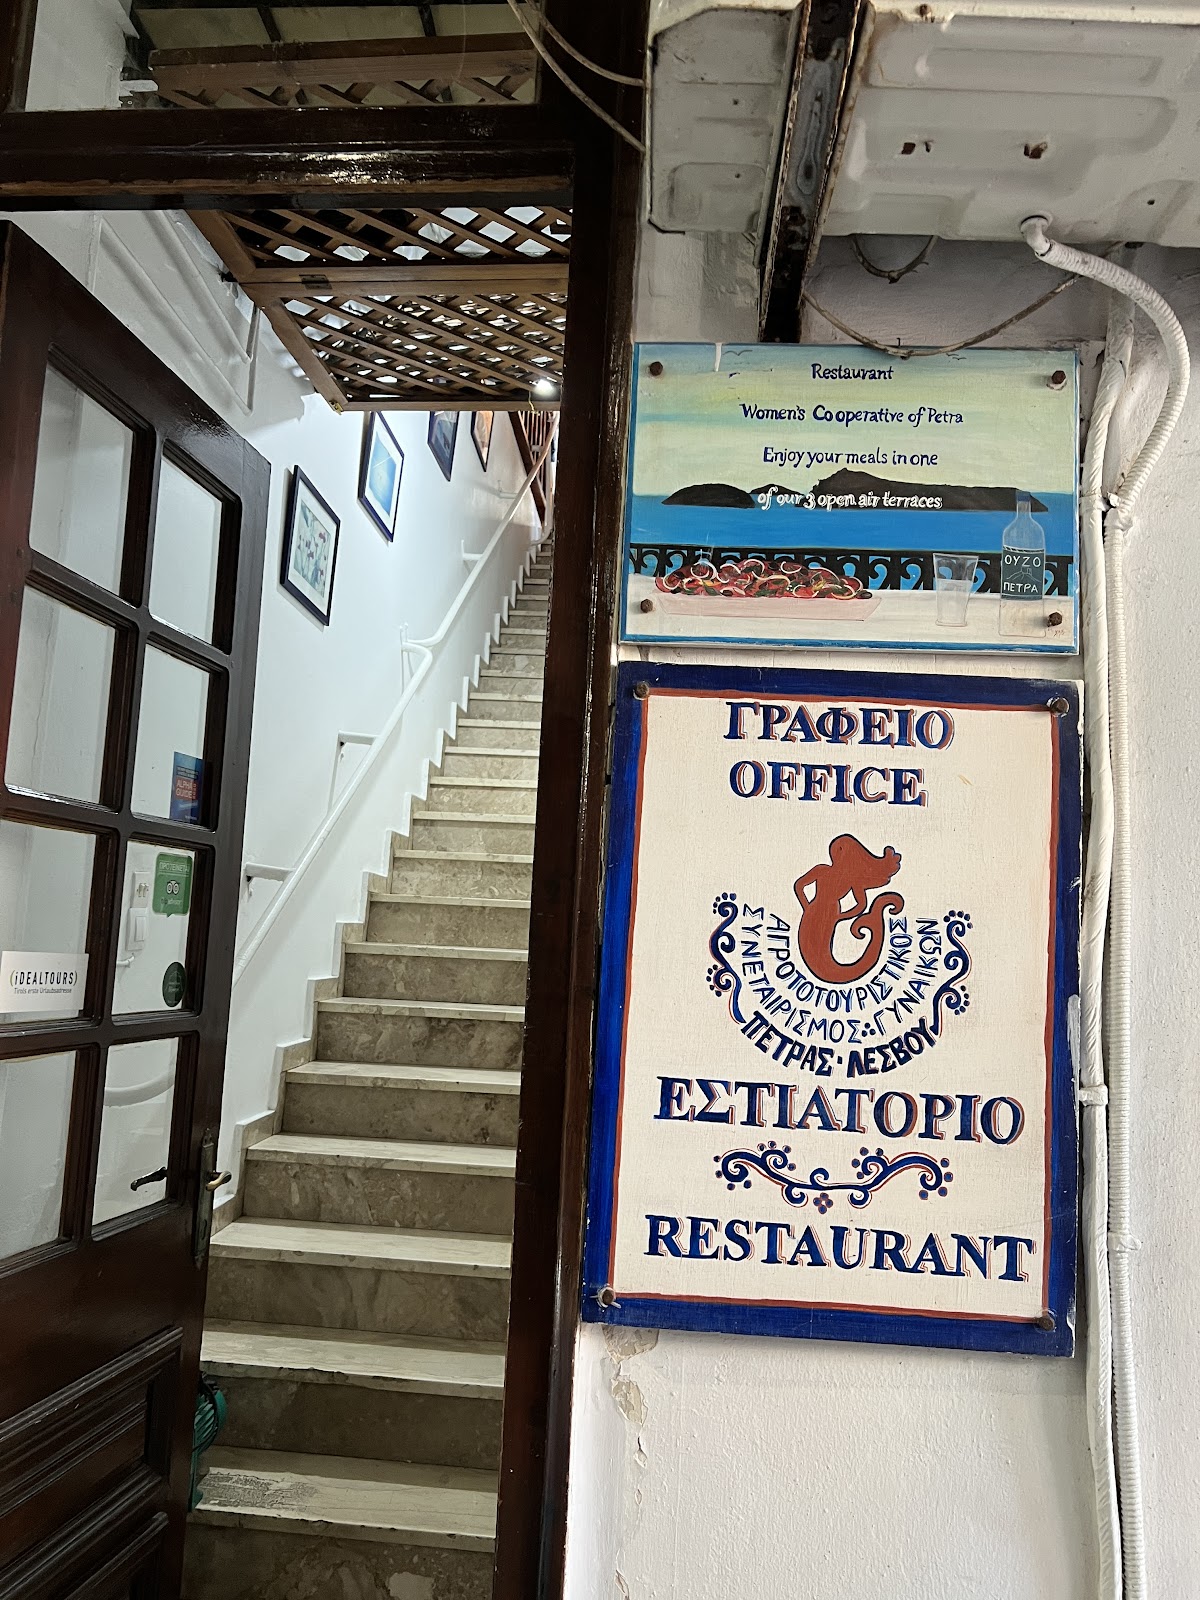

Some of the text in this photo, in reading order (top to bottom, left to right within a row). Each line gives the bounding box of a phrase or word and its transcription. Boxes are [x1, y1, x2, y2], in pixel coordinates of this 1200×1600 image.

[811, 363, 894, 381] Restaurant
[739, 403, 806, 421] Women's
[908, 406, 926, 428] of
[927, 407, 964, 424] Petra
[763, 446, 938, 469] Enjoy your meals in one
[757, 486, 943, 512] of our 3 open air terraces
[1003, 581, 1039, 593] ΠΕΤΡΑ
[723, 701, 955, 750] ΓΡΑΦΕΙΟ
[729, 760, 929, 807] OFFICE
[740, 903, 863, 1043] ΣΥΝΕΤΑΙΡΙΣΜΟΣ
[766, 913, 913, 1013] ΑΓΡΟΤΟΤΟΥΡΙΣΤΙΚΟΣ
[874, 917, 942, 1036] ΓΥΝΑΙΚΩΝ
[741, 1011, 937, 1078] ΠΕΤΡΑΣ ΛΕΣΒΟΥ
[653, 1076, 1025, 1145] ΕΣΤΙΑΤΟΡΙΟ
[644, 1214, 1038, 1282] RESTAURANT
